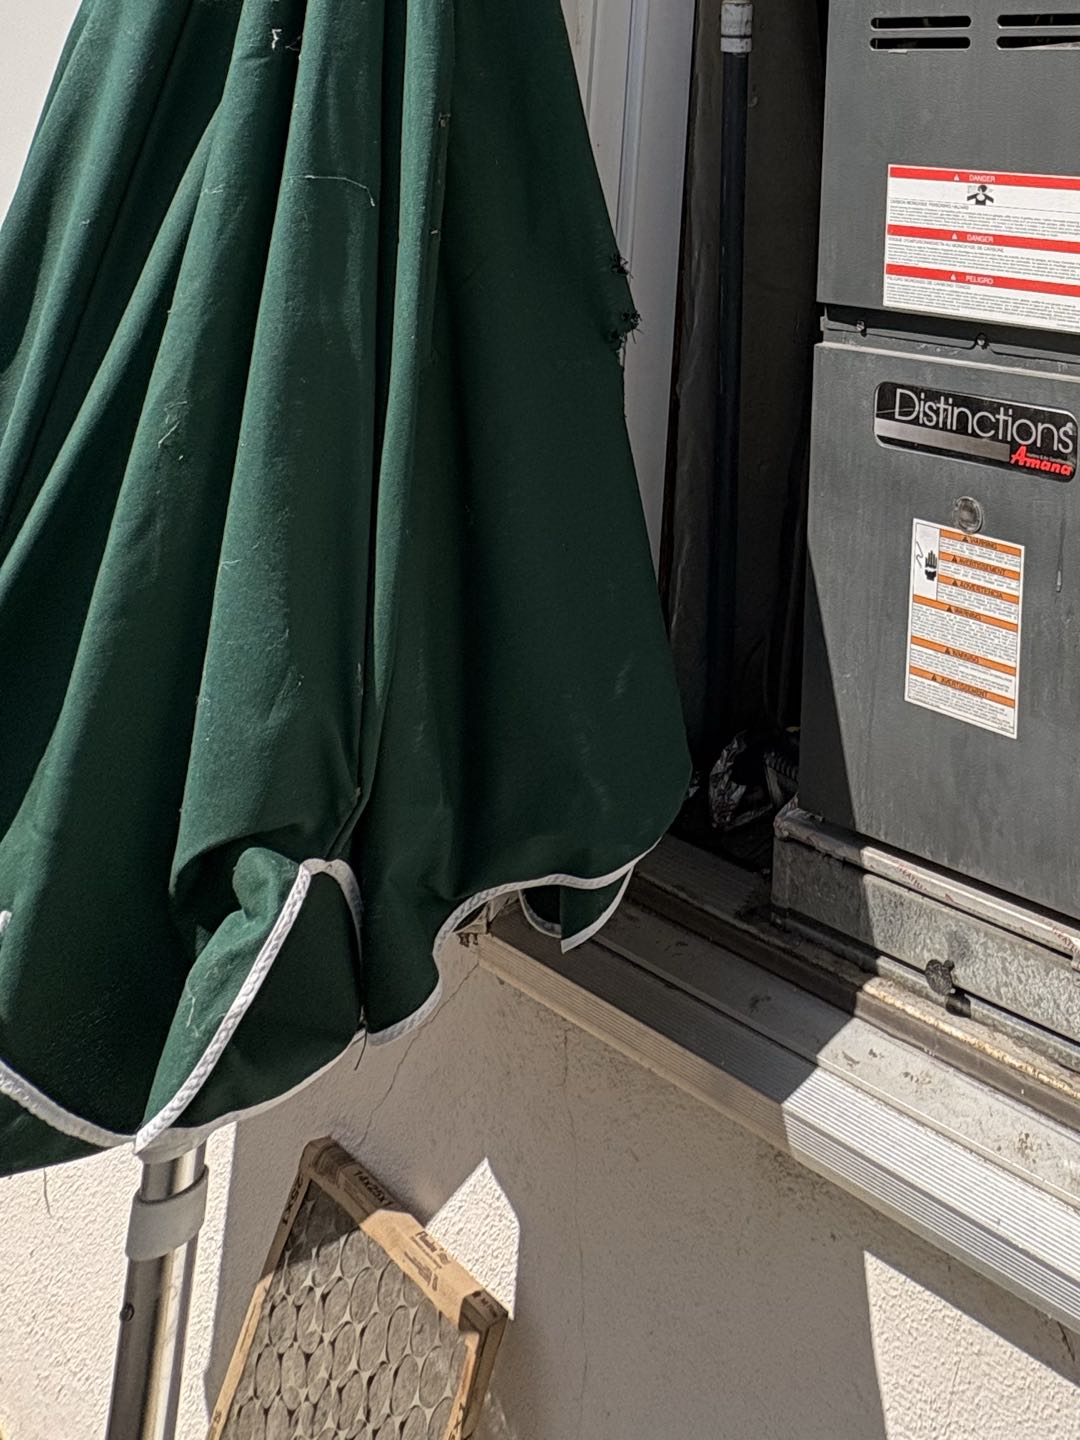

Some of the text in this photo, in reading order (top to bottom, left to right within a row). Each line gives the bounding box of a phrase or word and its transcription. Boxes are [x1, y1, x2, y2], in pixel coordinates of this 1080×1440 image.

[969, 174, 996, 183] DANGER
[967, 234, 994, 243] DANGER
[965, 275, 994, 285] PELIGRO
[895, 387, 1074, 454] Distinctions
[1010, 445, 1073, 476] Amana
